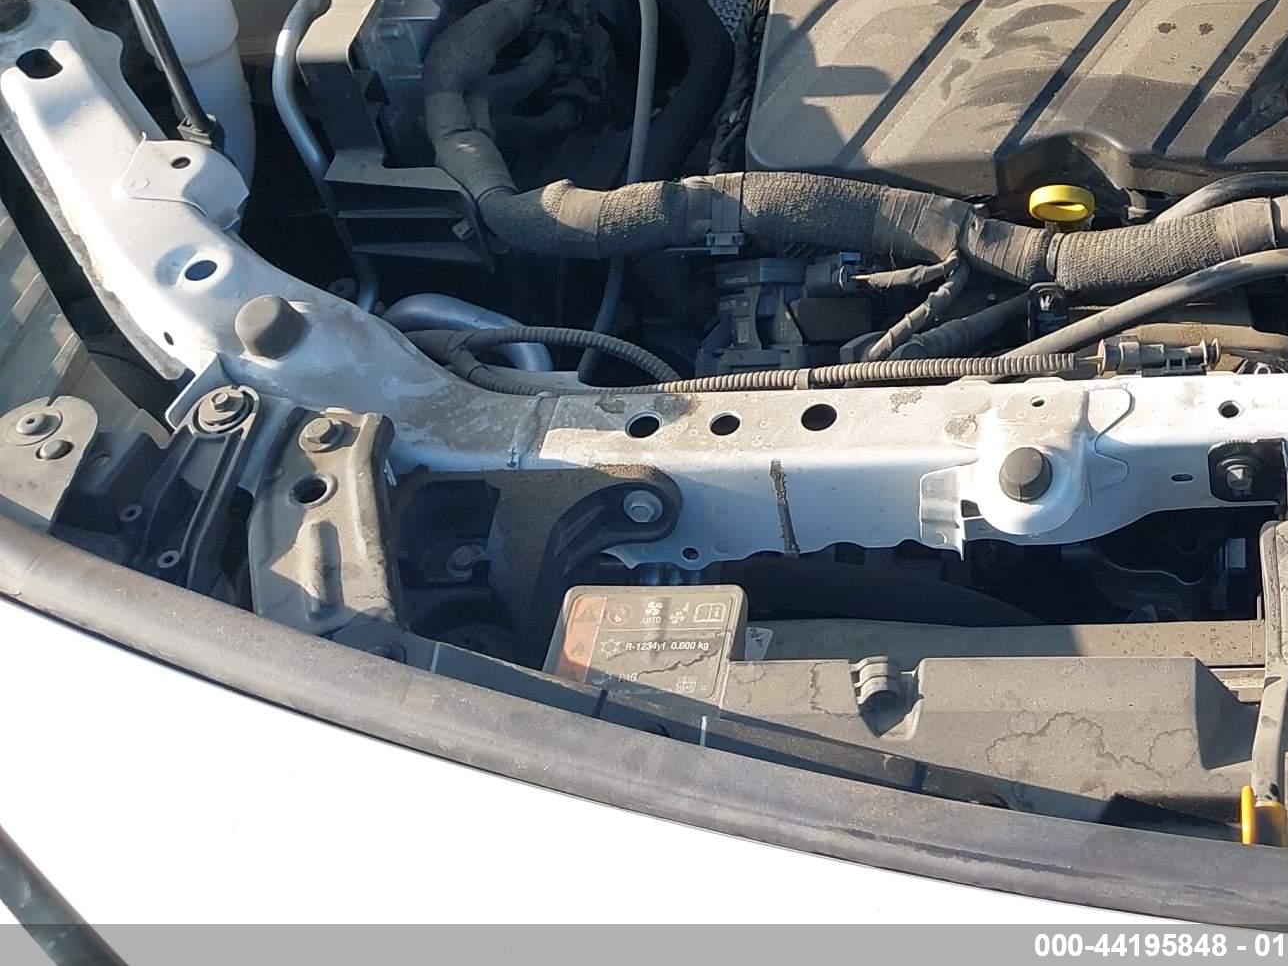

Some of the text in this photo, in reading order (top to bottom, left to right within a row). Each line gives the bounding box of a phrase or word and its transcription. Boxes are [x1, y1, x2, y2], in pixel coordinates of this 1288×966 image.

[641, 616, 661, 624] AUTO
[625, 641, 666, 651] R-1234yf
[697, 641, 709, 652] kg
[618, 672, 637, 683] PAG
